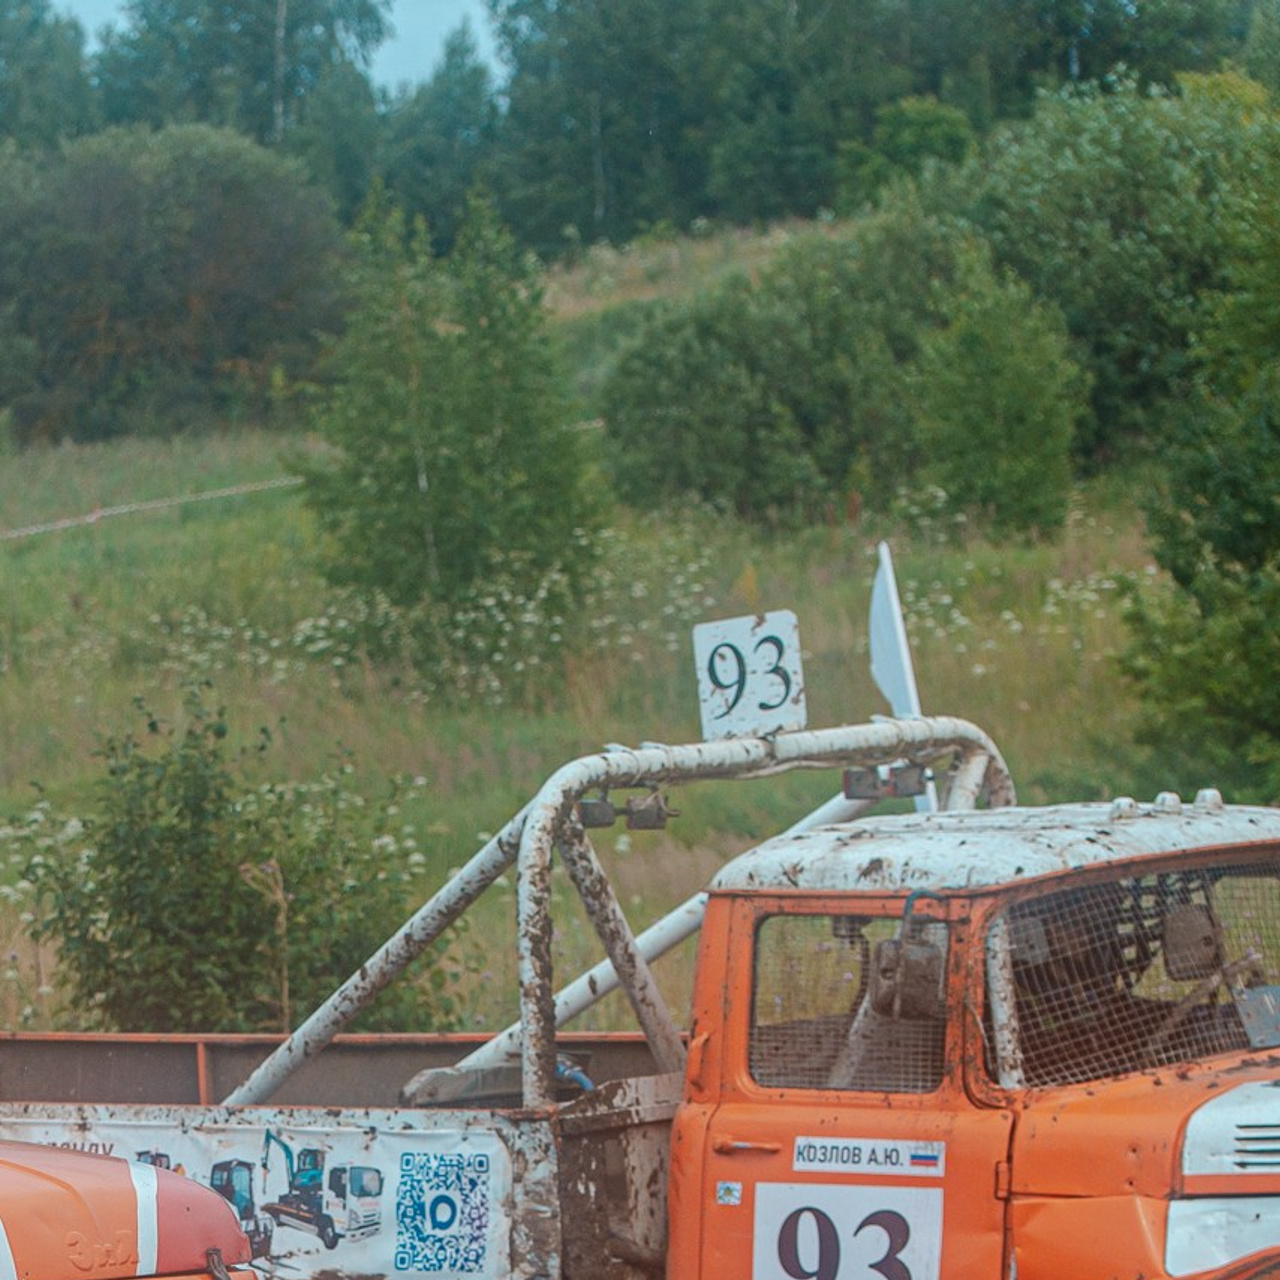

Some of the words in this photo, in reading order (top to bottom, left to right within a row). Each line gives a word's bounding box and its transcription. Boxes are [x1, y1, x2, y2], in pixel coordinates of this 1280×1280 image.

[707, 635, 792, 721] 93
[795, 1143, 862, 1165] КОЗЛОВ
[866, 1148, 904, 1167] А.Ю.
